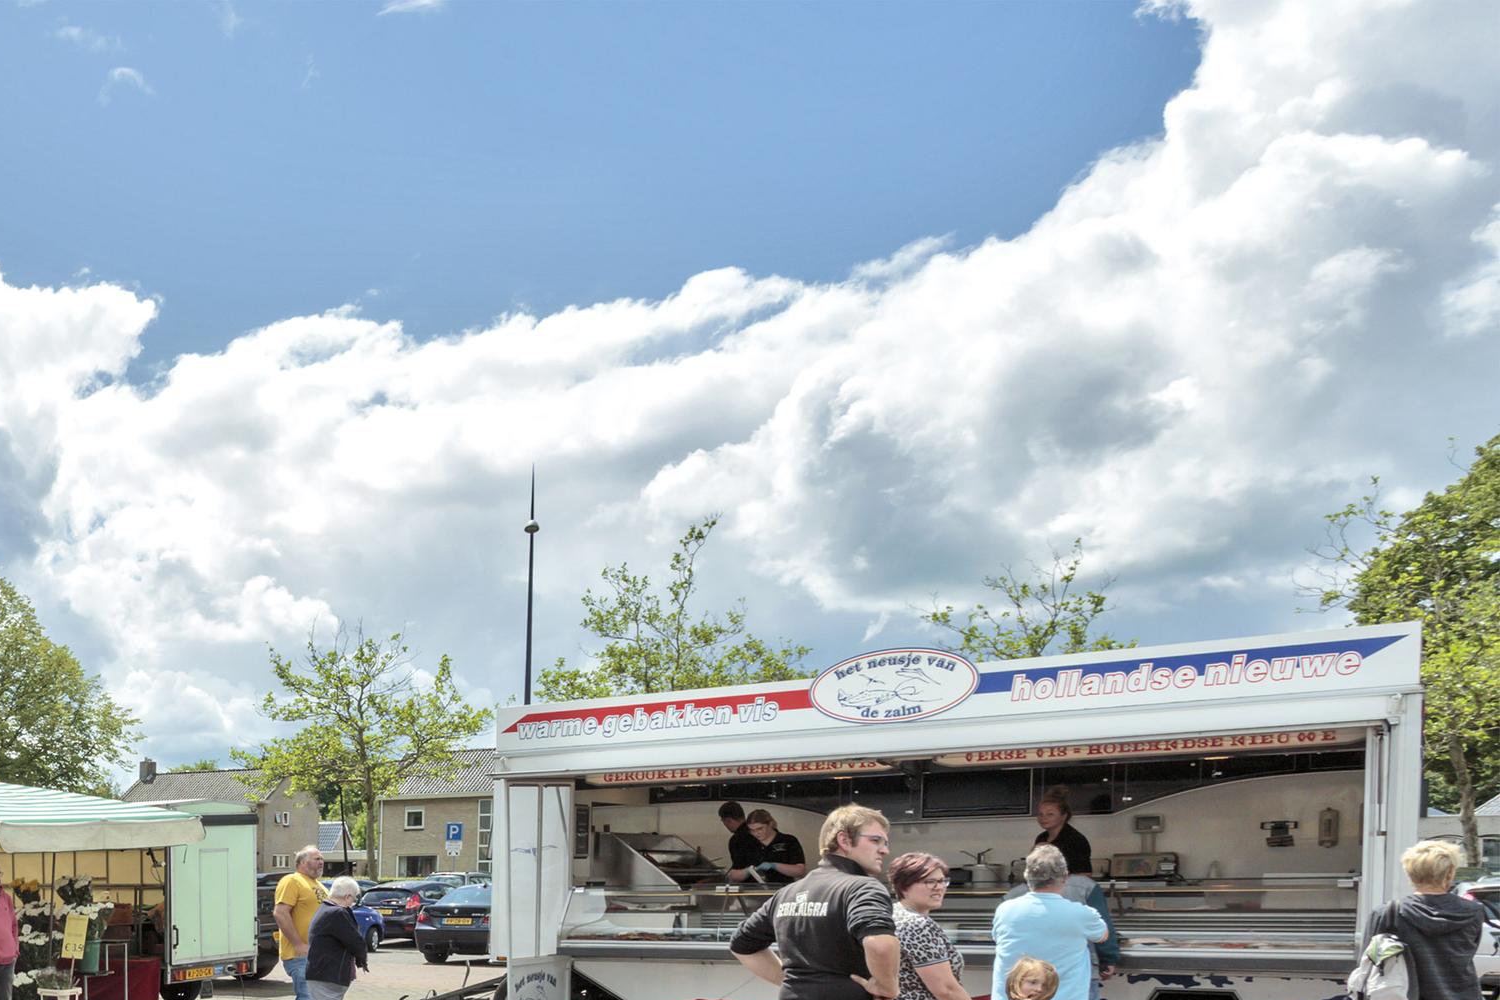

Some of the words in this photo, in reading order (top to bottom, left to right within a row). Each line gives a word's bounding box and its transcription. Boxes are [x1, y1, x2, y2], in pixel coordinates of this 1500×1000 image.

[834, 663, 863, 681] het
[867, 652, 921, 669] neusje
[927, 655, 957, 672] van
[1010, 662, 1198, 702] hollandse
[1203, 650, 1364, 687] nieuwe
[518, 714, 598, 740] warme
[602, 702, 732, 738] gebakken
[737, 696, 782, 723] vis
[861, 707, 879, 718] de
[884, 705, 923, 718] zalm
[450, 825, 459, 839] P
